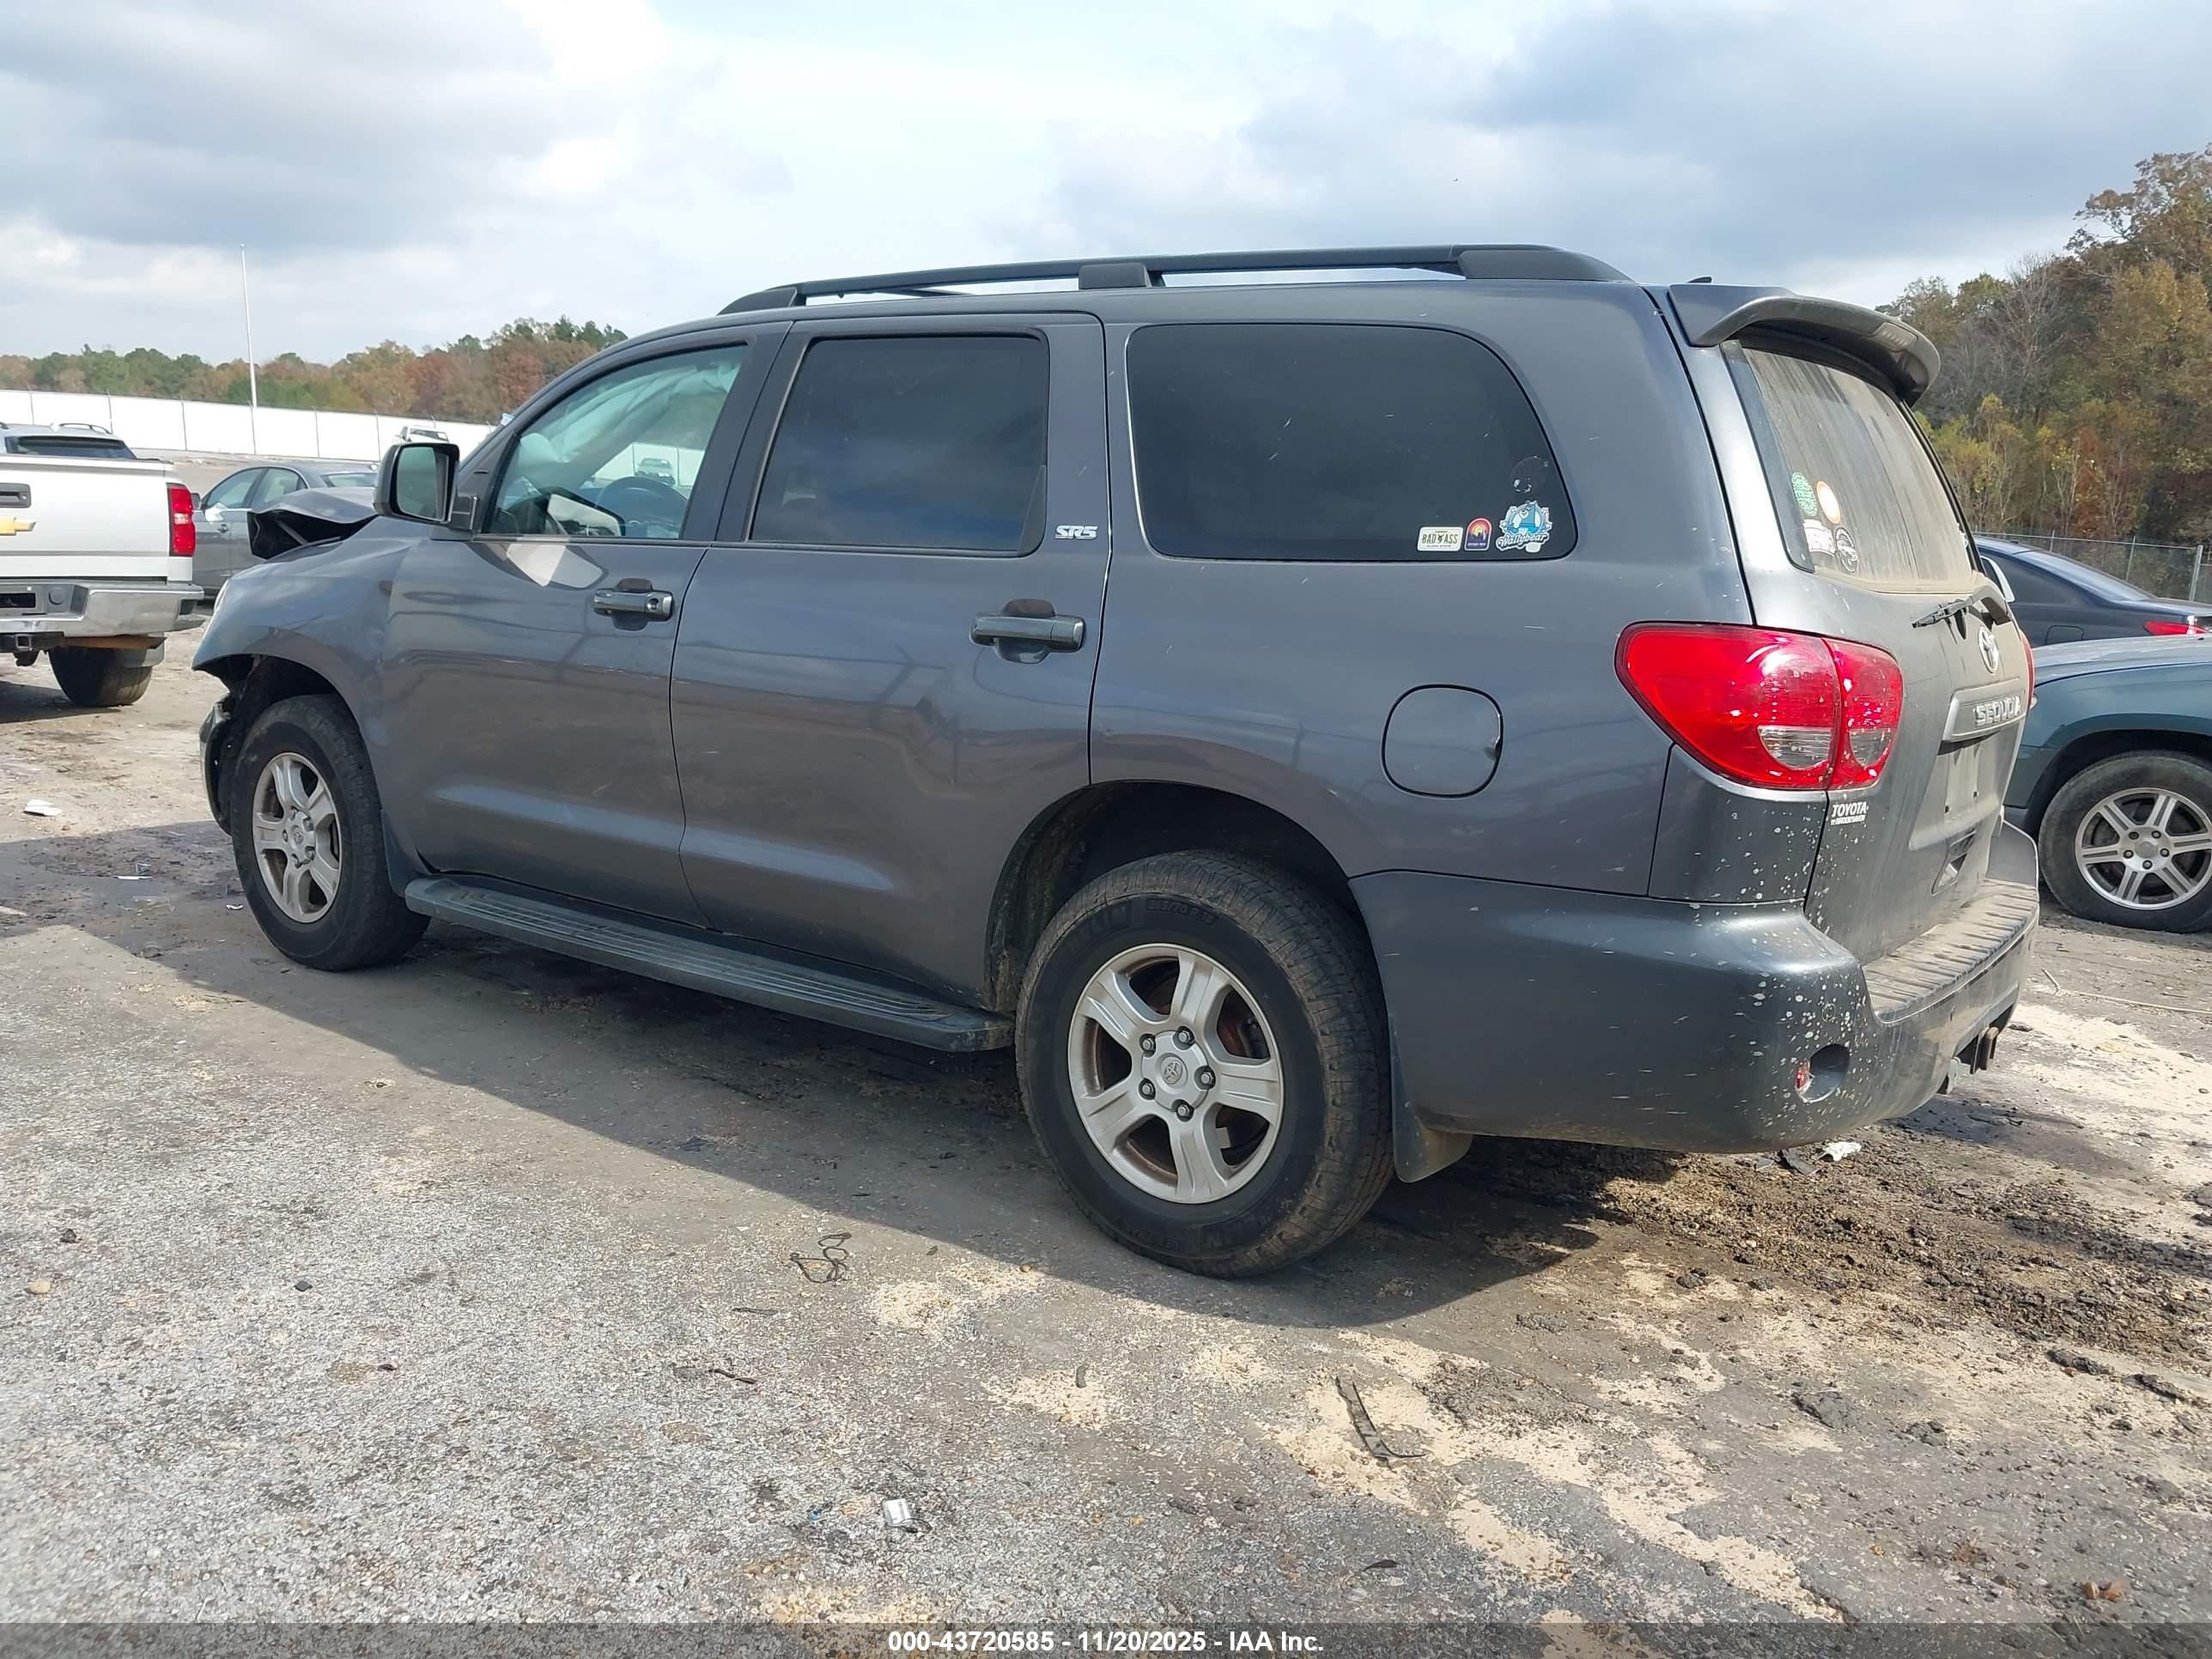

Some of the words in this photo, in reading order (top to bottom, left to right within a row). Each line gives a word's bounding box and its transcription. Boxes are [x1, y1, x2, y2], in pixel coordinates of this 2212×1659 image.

[1055, 525, 1098, 540] SR5
[1421, 533, 1436, 544] BAD
[1443, 533, 1459, 544] ASS
[1831, 801, 1867, 817] TOYOTA
